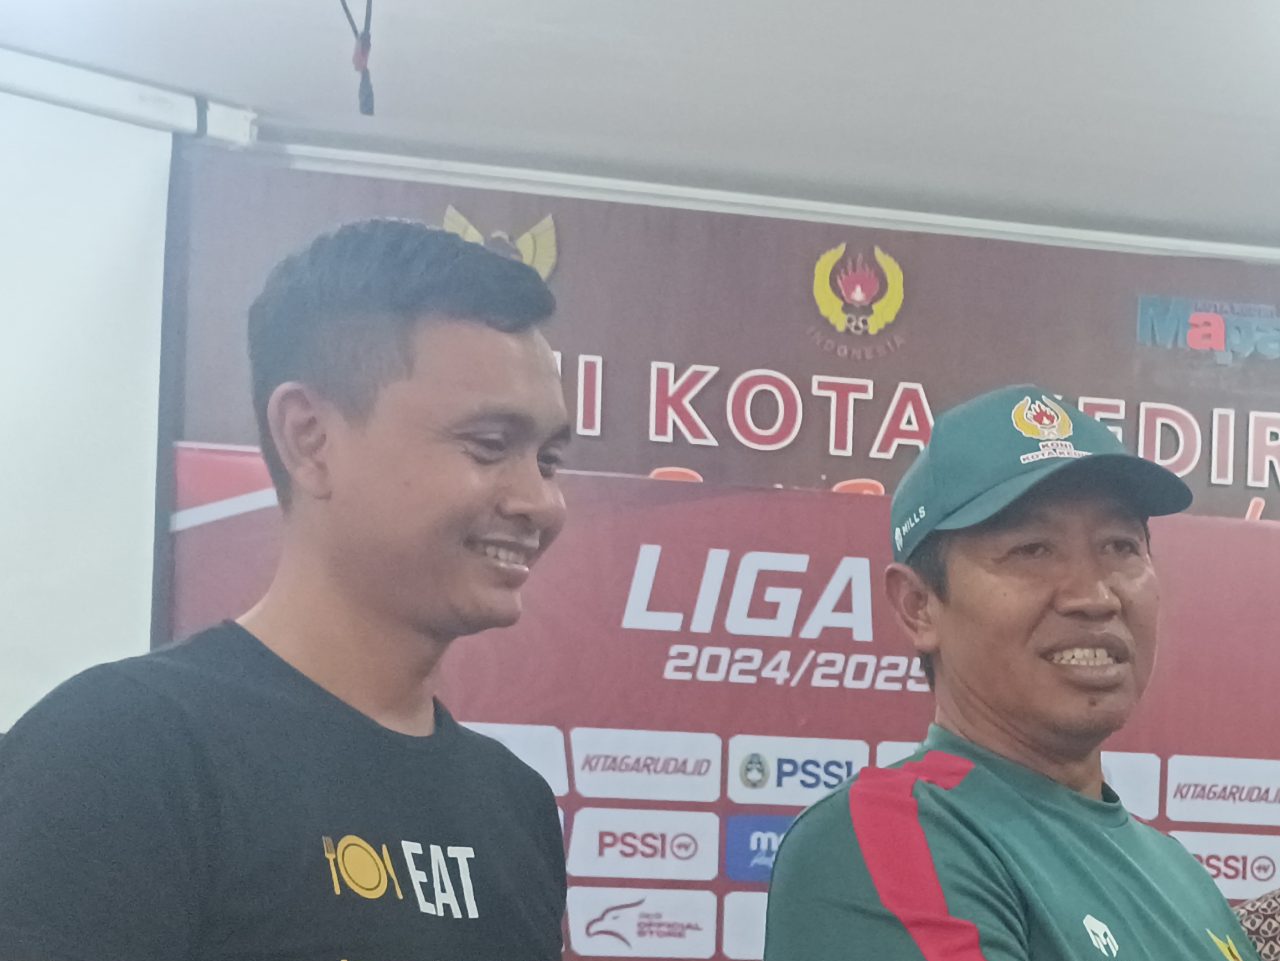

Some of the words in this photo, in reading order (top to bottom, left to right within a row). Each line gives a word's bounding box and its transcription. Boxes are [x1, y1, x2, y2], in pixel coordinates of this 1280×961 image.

[648, 361, 935, 460] KOTA
[901, 505, 926, 537] MILLS
[621, 544, 874, 642] LIGA
[663, 645, 932, 693] 2024/2025
[776, 757, 853, 789] PSSI
[598, 831, 667, 859] PSSI
[401, 840, 479, 919] EAT
[1193, 853, 1248, 881] SSI
